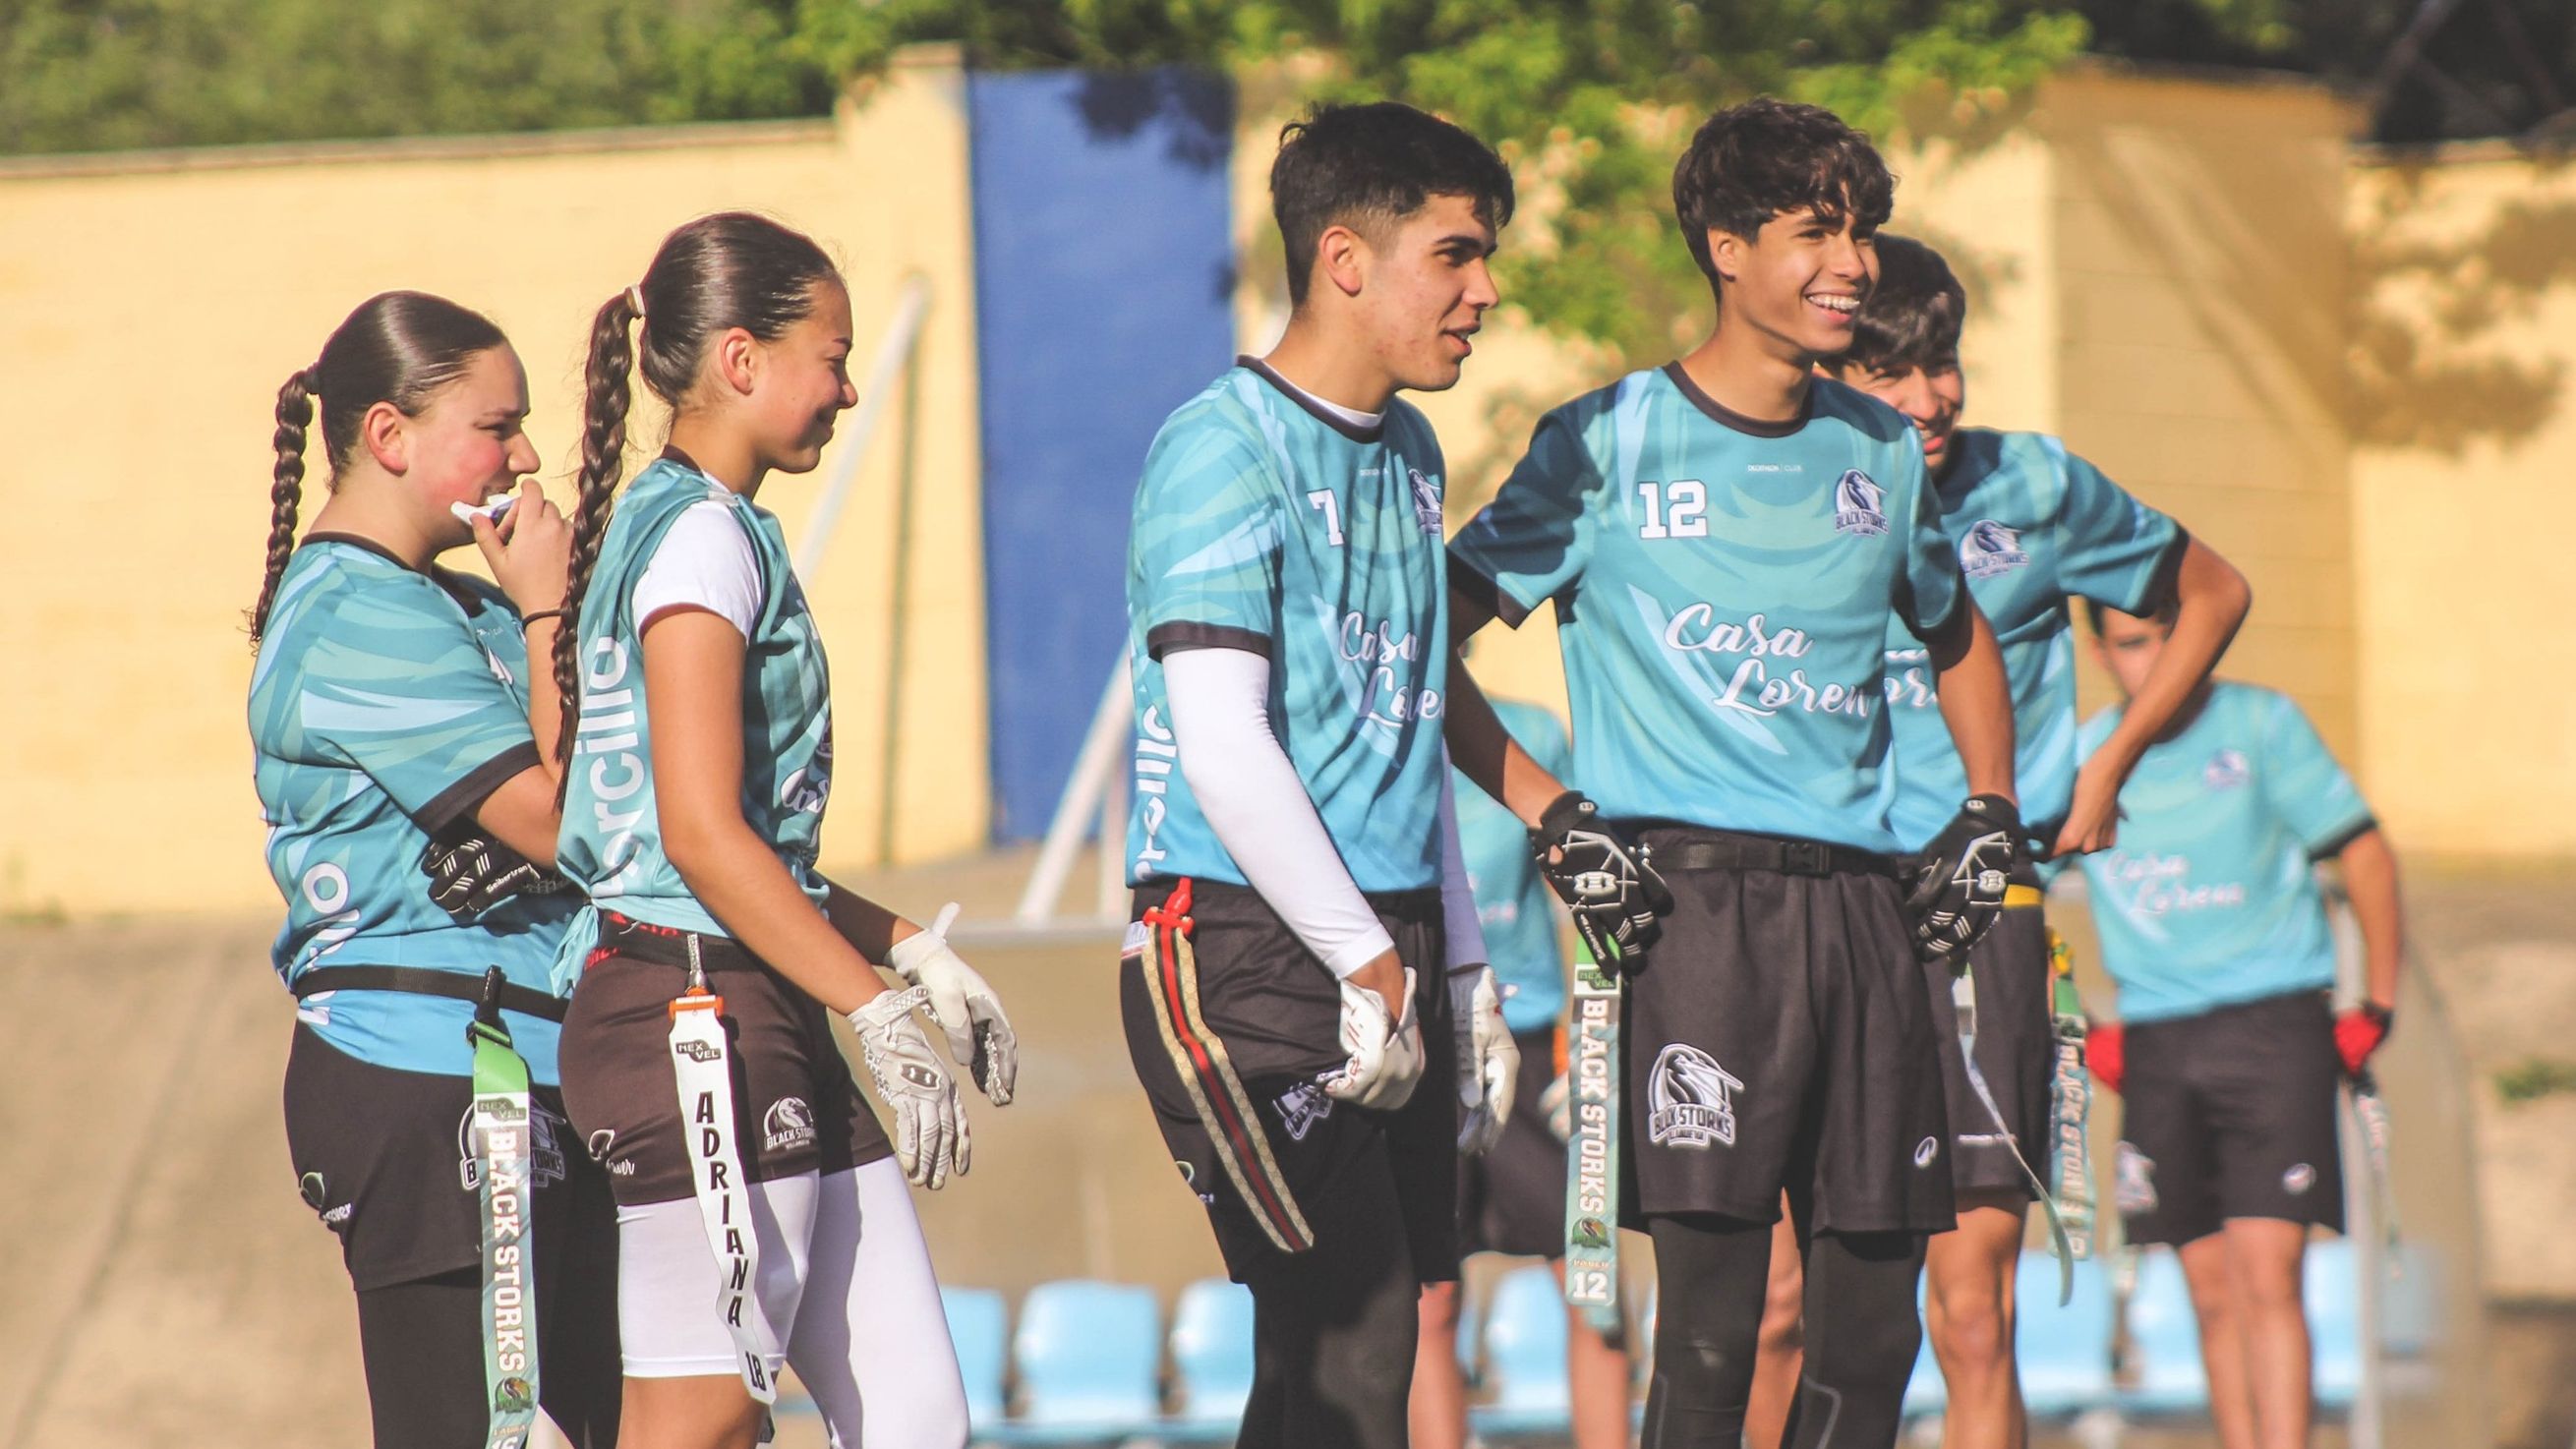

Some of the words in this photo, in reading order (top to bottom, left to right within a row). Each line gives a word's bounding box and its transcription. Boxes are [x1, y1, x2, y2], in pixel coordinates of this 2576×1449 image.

[1308, 489, 1344, 546] 7
[1638, 479, 1709, 540] 12
[1339, 610, 1420, 664] Casa
[1664, 602, 1815, 658] Casa
[1712, 656, 1869, 718] Loren
[574, 636, 647, 898] orcillo
[1580, 999, 1609, 1101] BLACK
[766, 1128, 795, 1151] BLACK
[1678, 1107, 1731, 1138] STORKS
[488, 1130, 520, 1240] BLACK
[1579, 1103, 1608, 1213] STORKS
[695, 1090, 749, 1328] ADRIANA
[744, 1350, 767, 1392] 18
[494, 1245, 526, 1372] STORKS
[1572, 1271, 1608, 1300] 12
